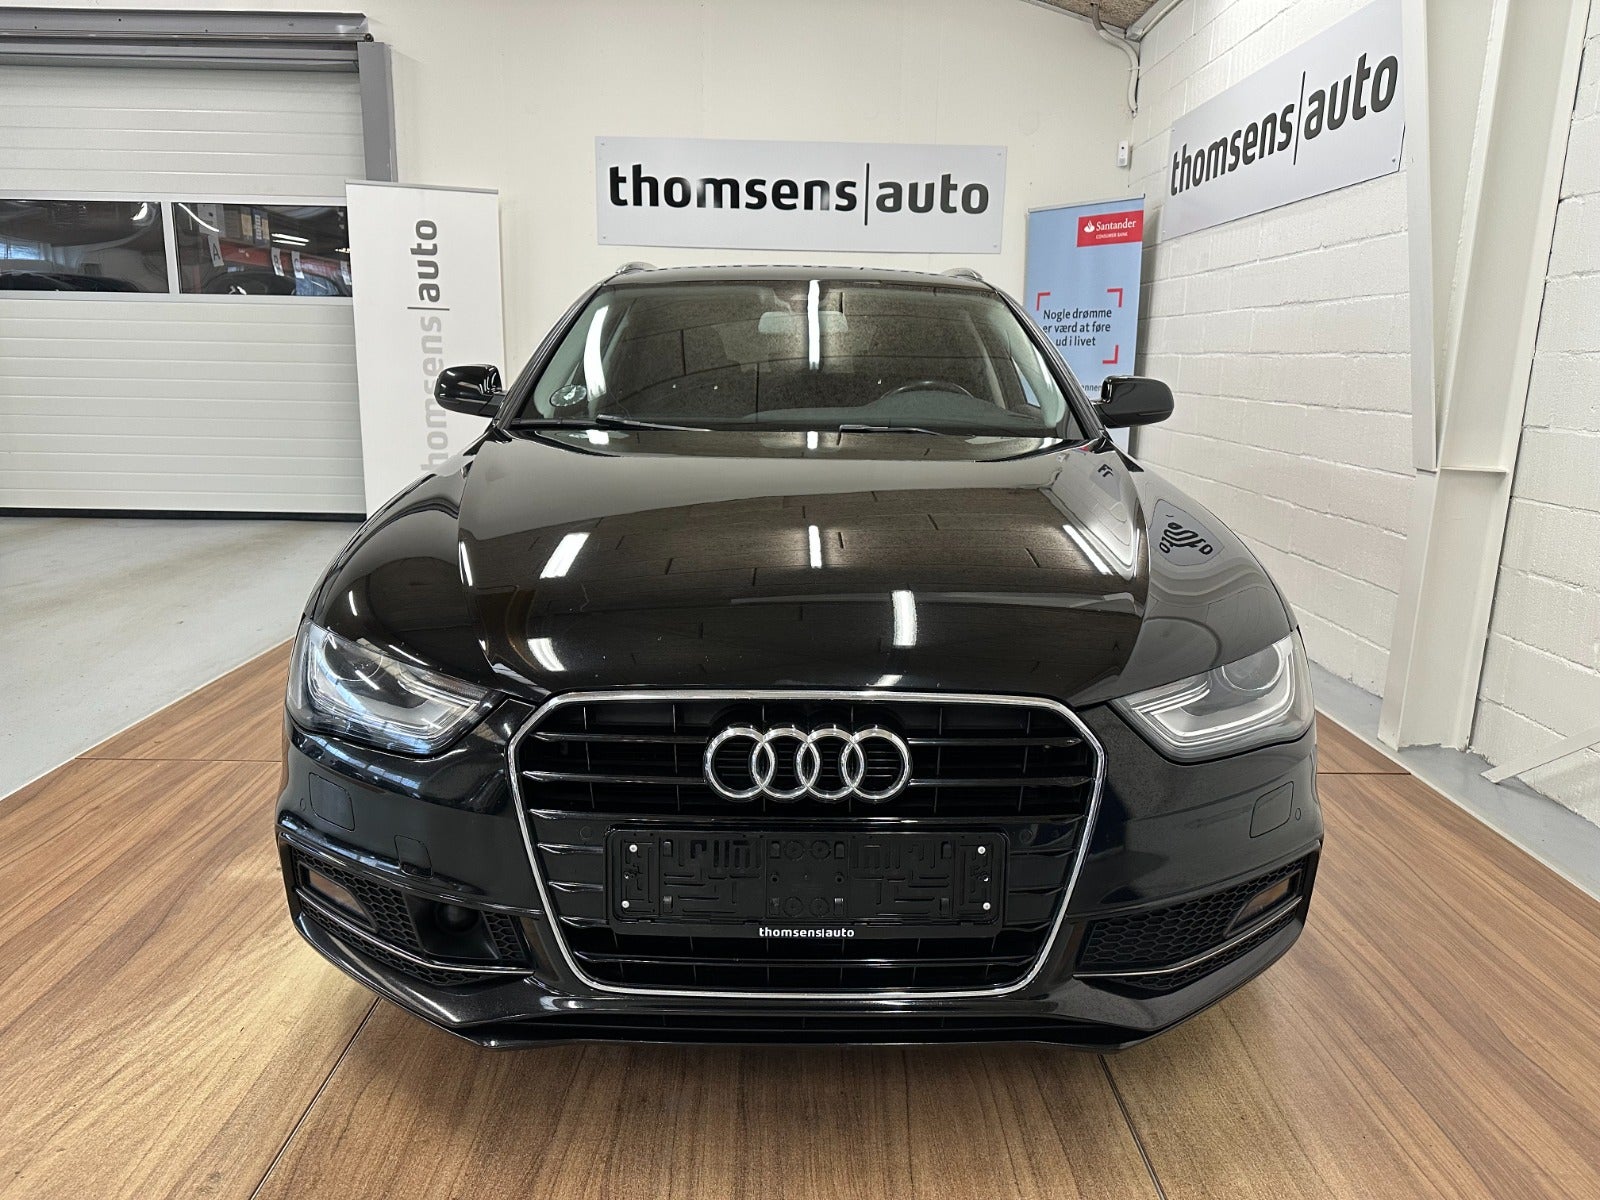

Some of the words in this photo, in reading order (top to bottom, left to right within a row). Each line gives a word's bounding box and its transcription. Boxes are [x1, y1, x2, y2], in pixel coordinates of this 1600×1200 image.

[1096, 218, 1137, 231] Santander
[1043, 308, 1071, 322] Nogle
[1072, 307, 1112, 319] drømme
[1042, 325, 1052, 333] er
[1054, 322, 1078, 333] værd
[1079, 323, 1090, 333] at
[1092, 321, 1111, 333] føre
[1055, 336, 1067, 346] ud
[1069, 336, 1073, 346] i
[1074, 335, 1096, 346] livet
